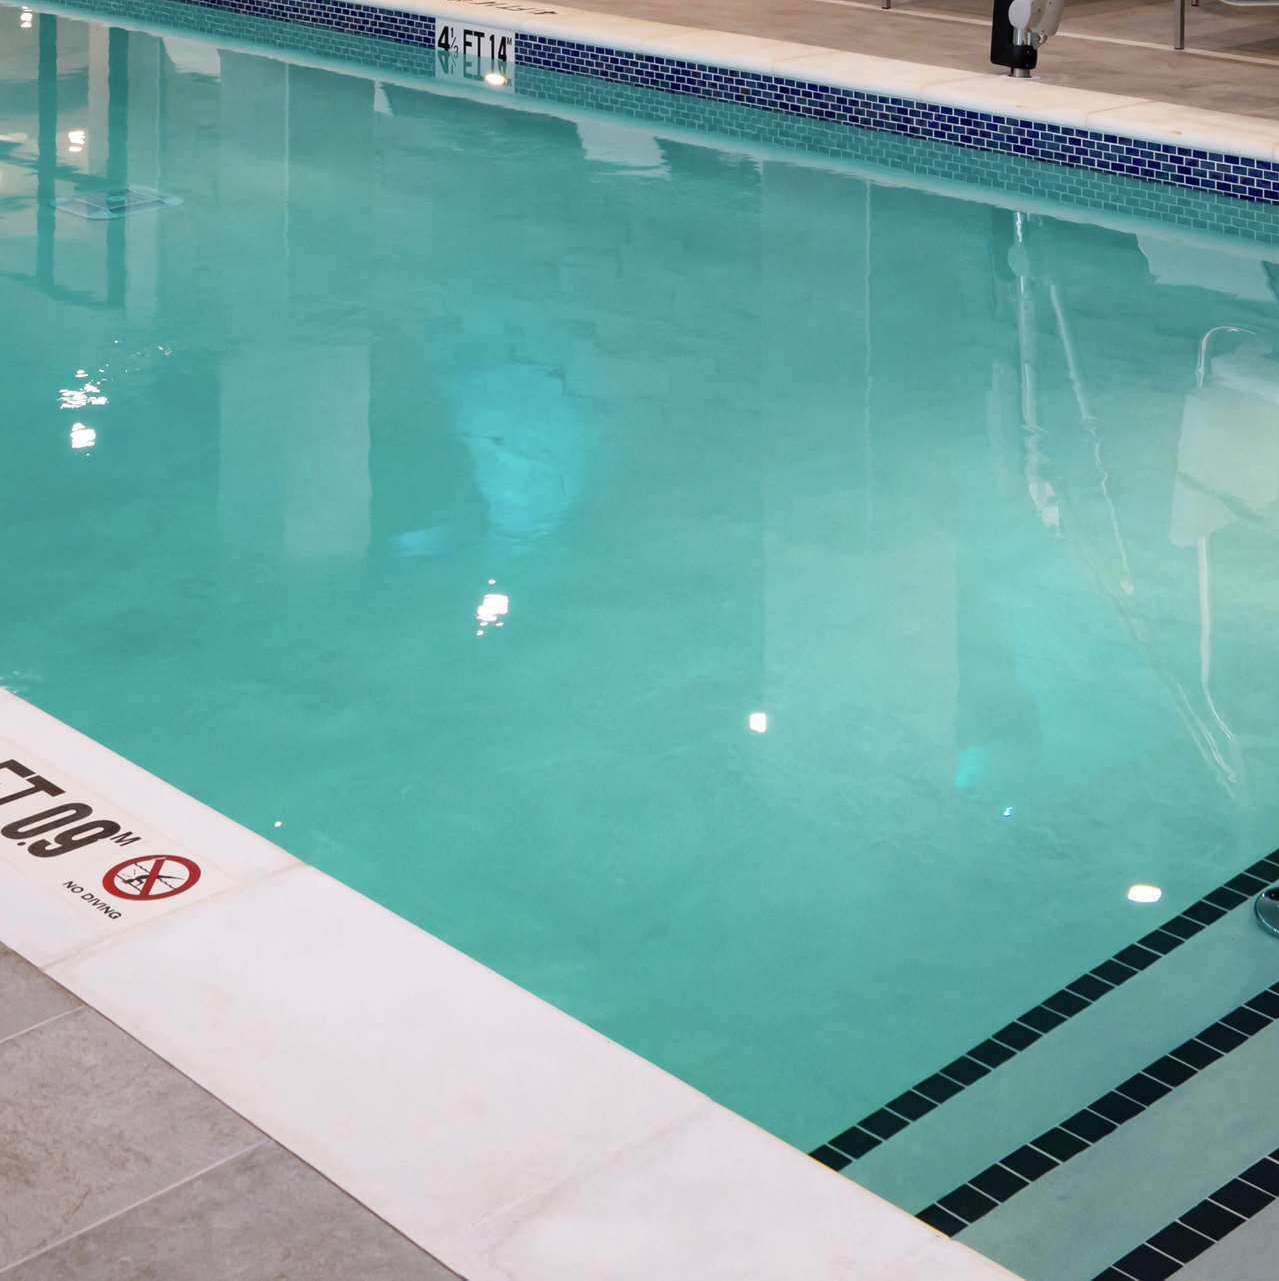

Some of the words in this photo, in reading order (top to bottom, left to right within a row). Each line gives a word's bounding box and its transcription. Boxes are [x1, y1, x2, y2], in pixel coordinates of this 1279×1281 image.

[463, 29, 484, 58] FT
[62, 880, 84, 894] NO
[81, 892, 122, 920] DIVING
